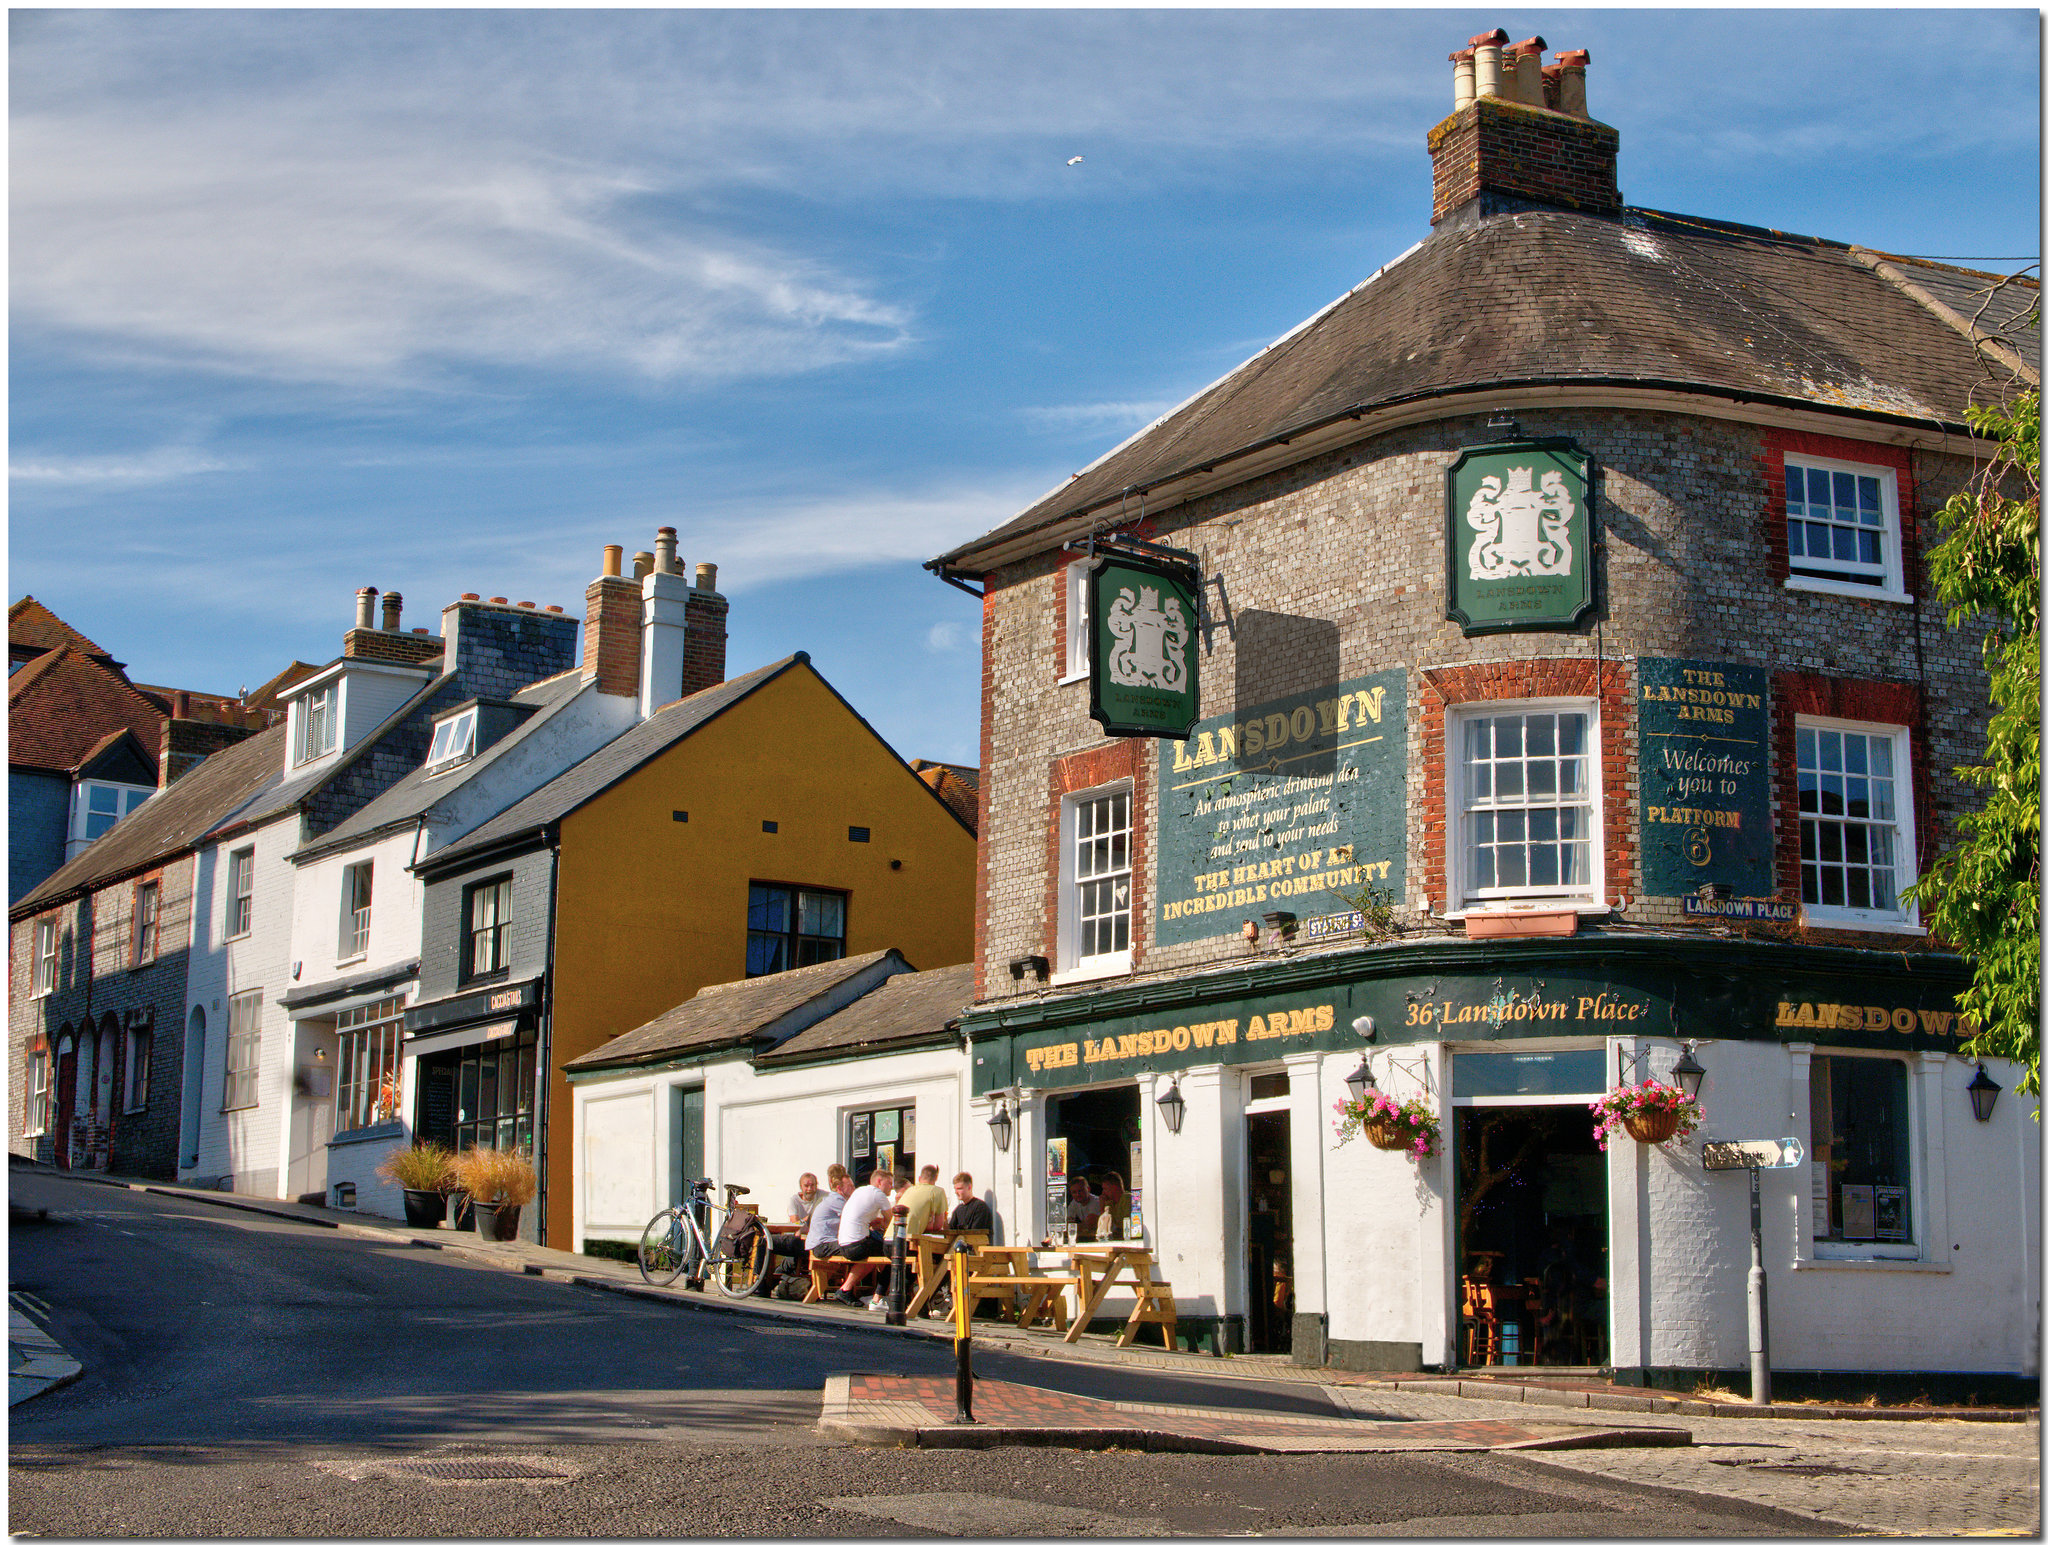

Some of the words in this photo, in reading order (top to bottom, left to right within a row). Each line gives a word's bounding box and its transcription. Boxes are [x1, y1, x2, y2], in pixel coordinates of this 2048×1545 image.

[1476, 585, 1564, 600] LANSDOWN
[1498, 600, 1542, 611] ARMS
[1683, 669, 1725, 687] THE
[1643, 685, 1762, 710] LANSDOWN
[1172, 685, 1386, 774] LANSDOWN
[1677, 705, 1735, 724] ARMS
[1663, 748, 1750, 776] Welcomes
[1194, 799, 1212, 817] An
[1214, 782, 1280, 813] atmospheric
[1283, 769, 1333, 794] drinking
[1676, 776, 1713, 801] you
[1720, 782, 1737, 795] to
[1218, 818, 1230, 833] to
[1232, 811, 1261, 831] whet
[1263, 806, 1290, 831] your
[1289, 794, 1331, 827] palate
[1647, 806, 1741, 829] PLATFORM
[1210, 835, 1235, 859] and
[1235, 829, 1261, 854] tend
[1263, 832, 1274, 847] to
[1277, 826, 1305, 851] your
[1307, 812, 1340, 839] needs
[1682, 827, 1712, 867] 6
[1194, 870, 1230, 893] THE
[1232, 855, 1296, 885] HEART
[1298, 850, 1323, 871] OF
[1326, 844, 1355, 867] AN
[1163, 884, 1267, 921] INCREDIBLE
[1269, 860, 1393, 898] COMMUNITY
[1686, 898, 1753, 917] LANSDOWN
[1757, 903, 1794, 919] PLACE
[1405, 1002, 1434, 1026] 36
[1441, 993, 1567, 1024] Lansdown
[1575, 993, 1640, 1021] Place
[1775, 1001, 1981, 1037] LANSDOWN
[1026, 1042, 1079, 1072] THE
[1084, 1019, 1238, 1063] LANSDOWN
[1245, 1004, 1335, 1042] ARMS
